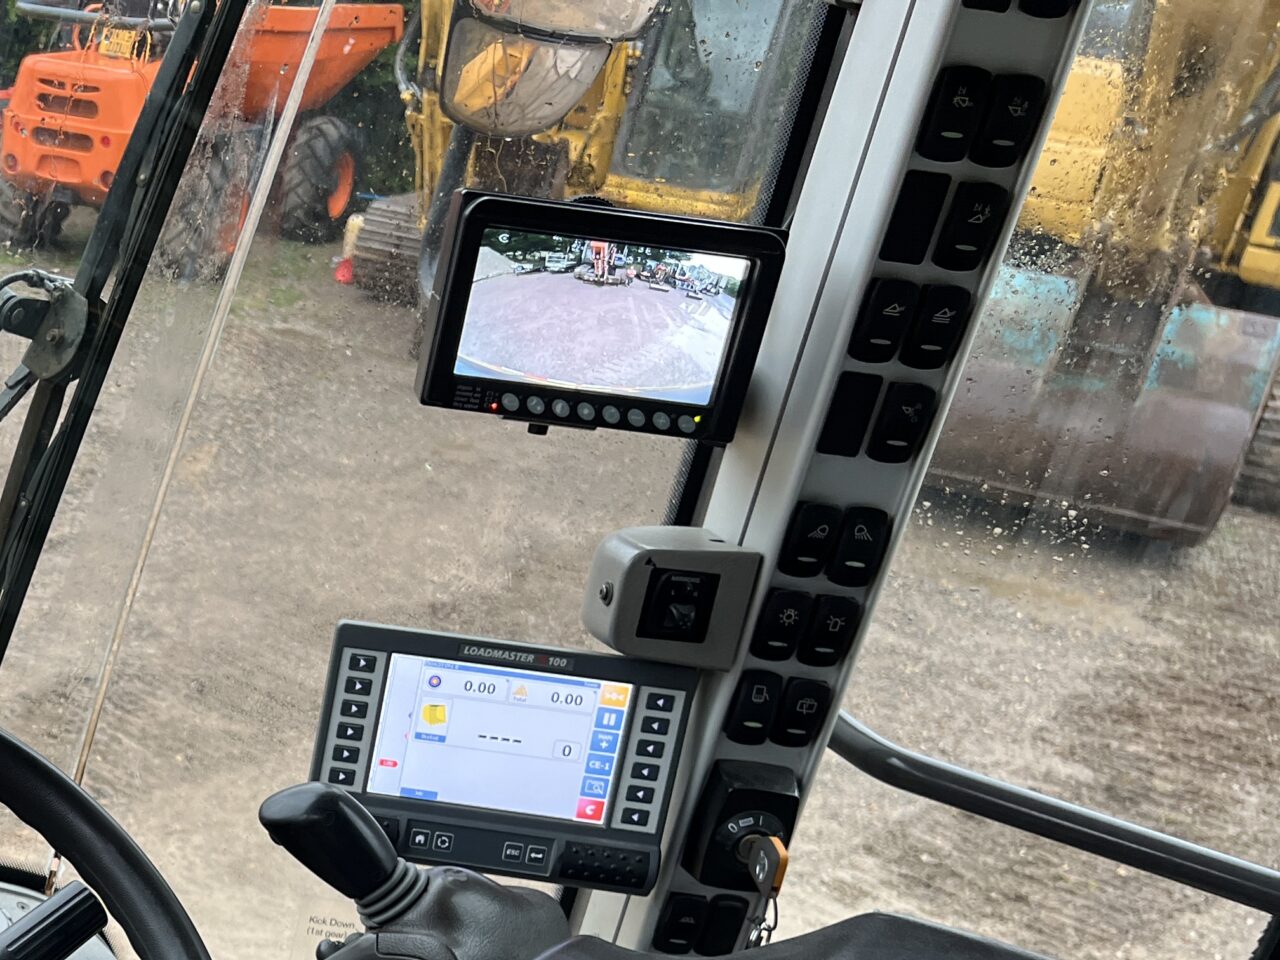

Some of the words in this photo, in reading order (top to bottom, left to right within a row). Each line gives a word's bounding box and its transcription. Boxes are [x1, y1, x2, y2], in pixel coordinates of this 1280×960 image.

[463, 645, 535, 663] LOADMASTER
[464, 680, 496, 694] 0.00
[551, 691, 583, 706] 0.00
[562, 744, 572, 757] 0
[588, 760, 610, 771] CE-1
[506, 848, 520, 856] ESC
[308, 915, 327, 926] Kick
[329, 918, 355, 929] Down
